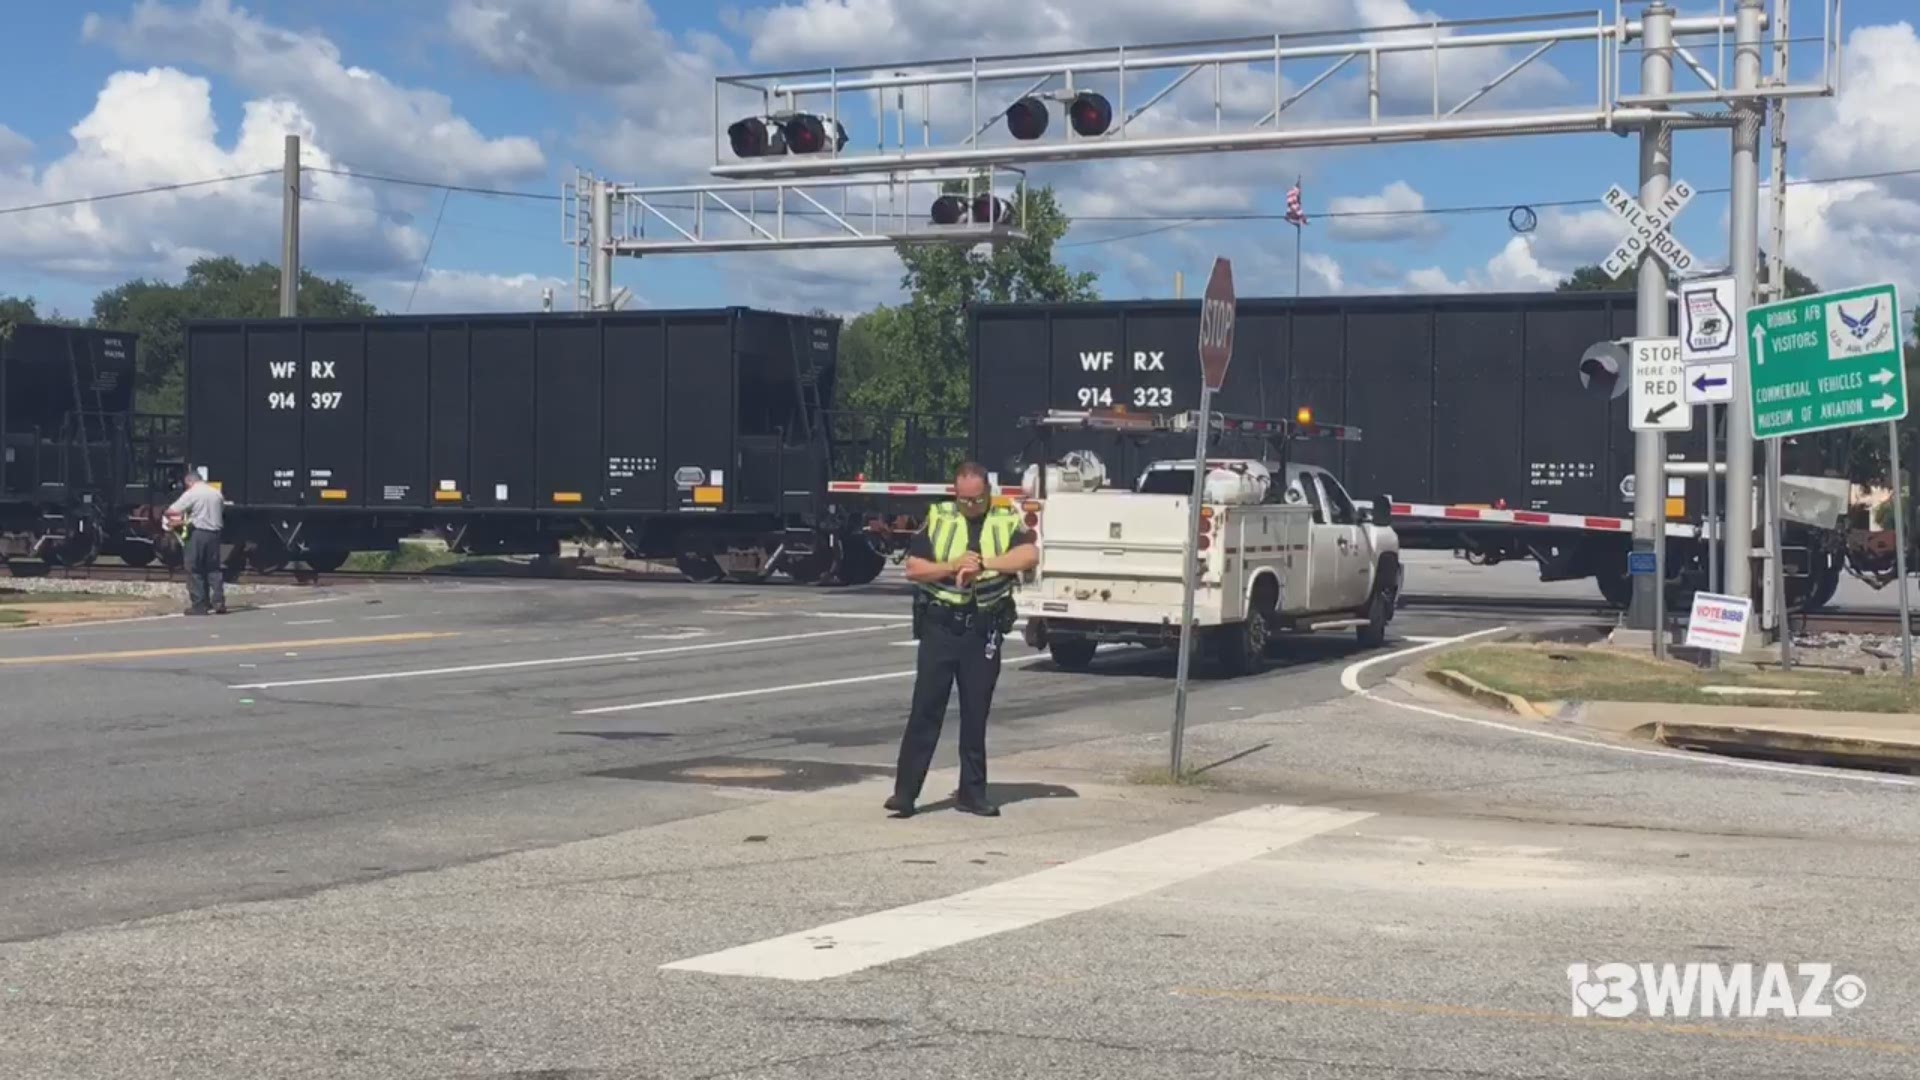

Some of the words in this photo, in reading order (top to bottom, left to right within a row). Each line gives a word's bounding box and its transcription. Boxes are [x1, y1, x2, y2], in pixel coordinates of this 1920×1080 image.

[1605, 184, 1690, 273] CROSSING
[1605, 188, 1641, 227] RAIL
[1651, 231, 1691, 270] ROAD
[1804, 304, 1821, 322] AFB
[1202, 299, 1233, 348] STOP
[1771, 330, 1818, 354] VISITORS
[269, 360, 297, 379] WF
[310, 360, 336, 379] RX
[1079, 351, 1114, 371] WF
[1133, 351, 1165, 371] RX
[1636, 365, 1664, 376] HERE
[1077, 387, 1113, 407] 914
[1133, 387, 1173, 407] 323
[1644, 380, 1678, 395] RED
[1756, 380, 1811, 404] COMMERCIAL
[1818, 371, 1863, 393] VEHICLES
[268, 391, 296, 410] 914
[310, 391, 343, 410] 397
[1757, 408, 1794, 430] MUSEUM
[1800, 404, 1814, 424] OF
[1820, 398, 1864, 420] AVIATION
